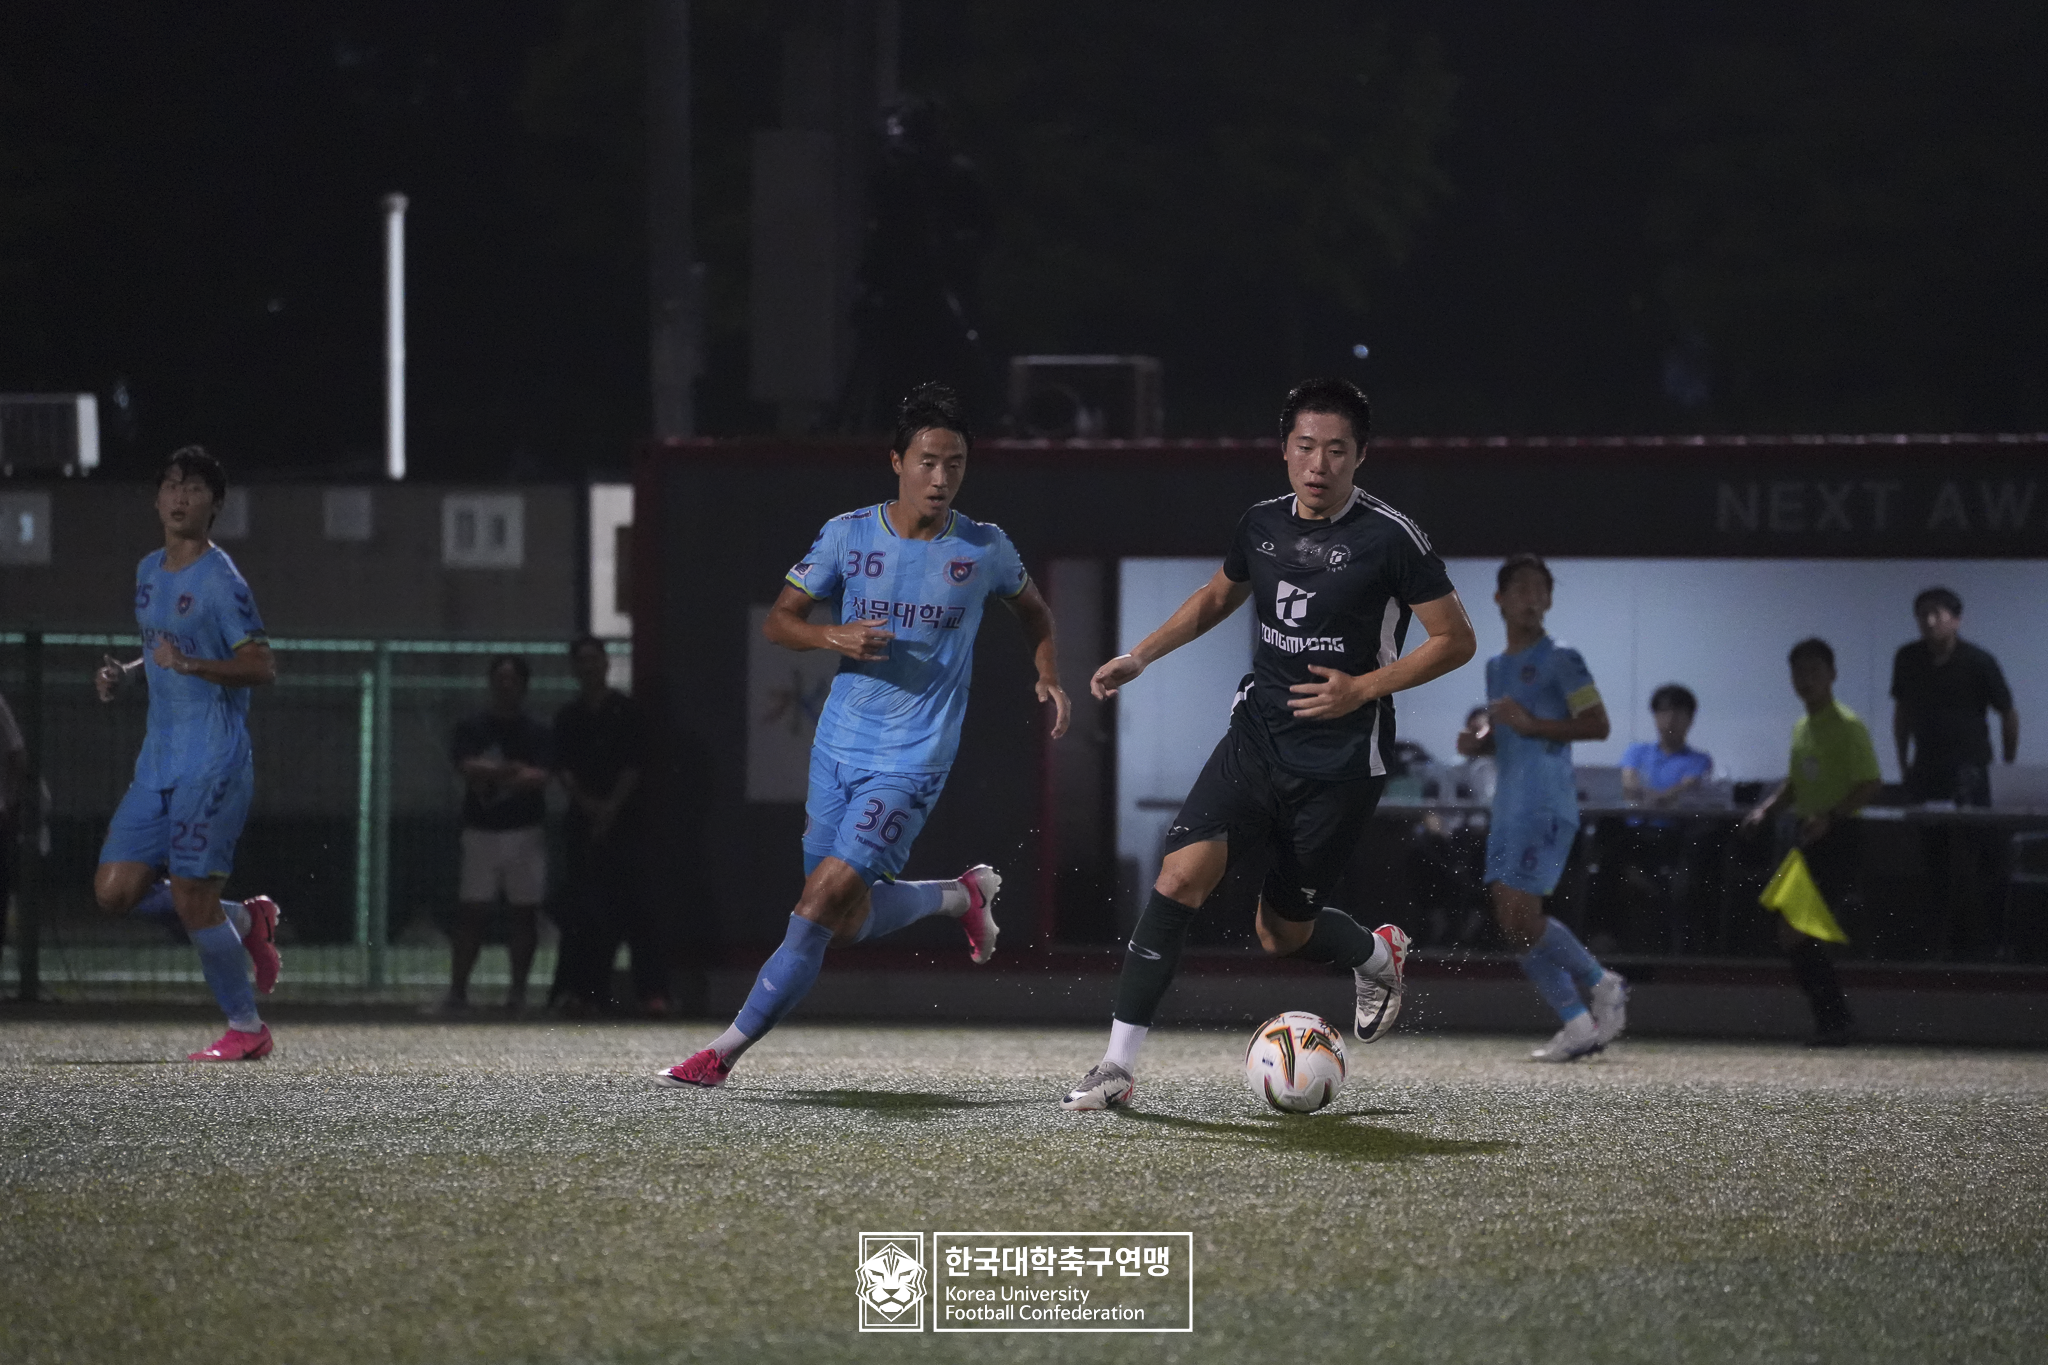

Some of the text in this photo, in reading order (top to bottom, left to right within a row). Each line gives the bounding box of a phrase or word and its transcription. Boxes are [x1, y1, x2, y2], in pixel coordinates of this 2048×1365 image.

[1715, 480, 2048, 532] NEXT AW
[846, 549, 886, 580] 36
[852, 596, 967, 630] 선문대학교
[171, 821, 209, 852] 25
[853, 797, 911, 846] 36
